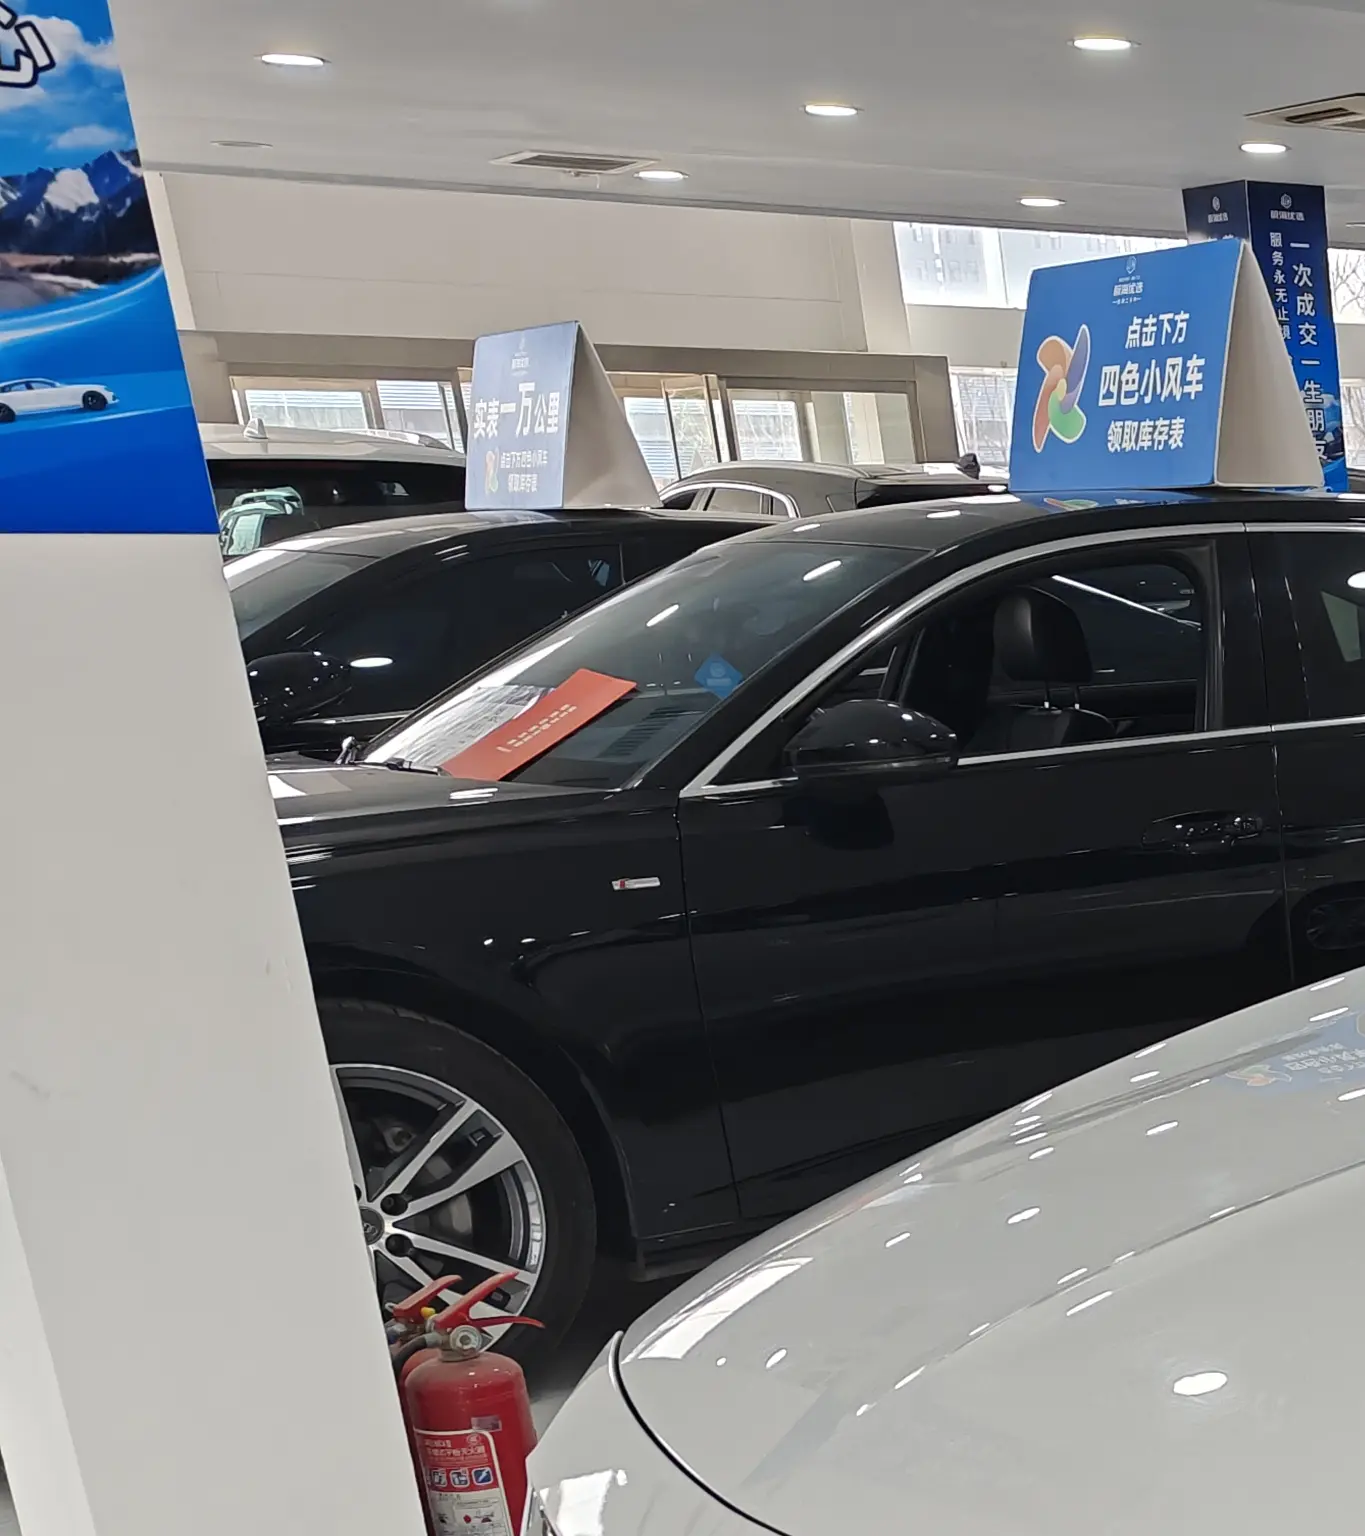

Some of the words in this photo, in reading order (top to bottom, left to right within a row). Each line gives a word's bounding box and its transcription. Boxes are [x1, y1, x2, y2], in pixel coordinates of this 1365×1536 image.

[1124, 310, 1190, 350] 点击下方
[1289, 241, 1328, 461] 一次成交一生朋友
[1098, 353, 1206, 408] 四色小风车
[473, 382, 560, 440] 实表一万公里
[1107, 416, 1187, 453] 领取库存表
